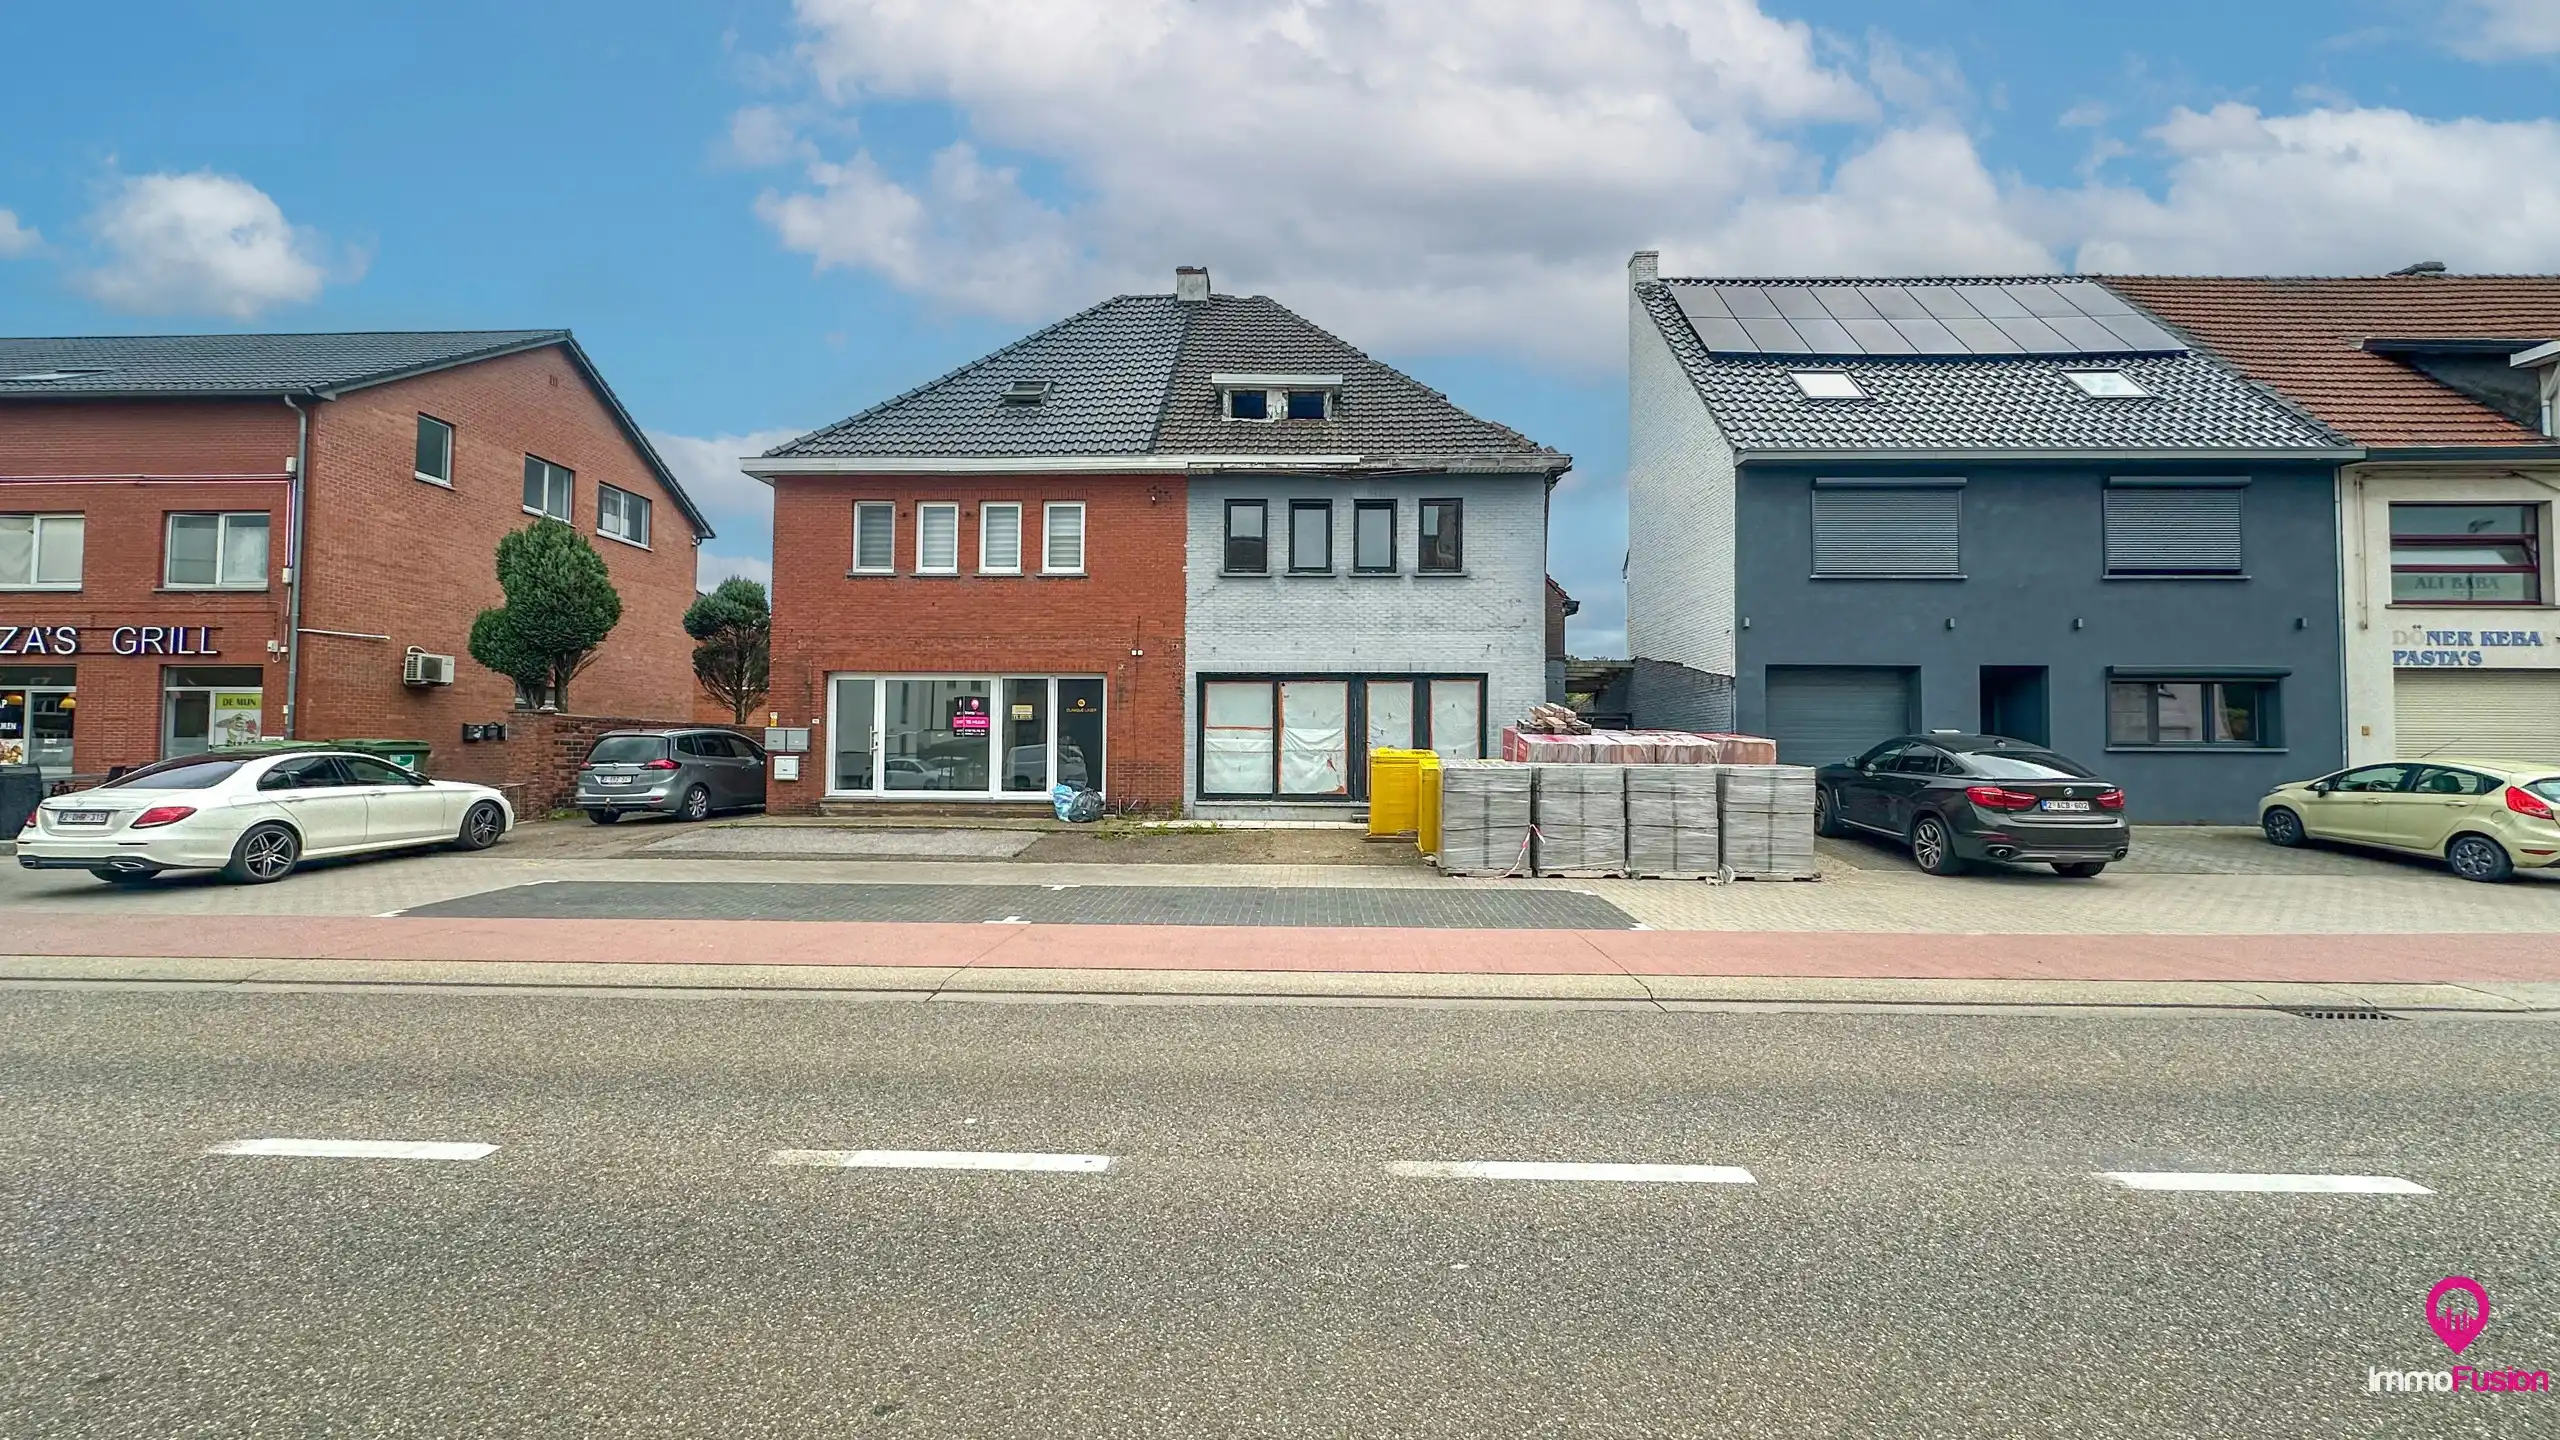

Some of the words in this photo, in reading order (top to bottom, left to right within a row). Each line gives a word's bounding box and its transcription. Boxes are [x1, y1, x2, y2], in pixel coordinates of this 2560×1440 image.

[2414, 576, 2444, 589] ALI
[2451, 576, 2500, 589] BABA
[112, 626, 218, 655] GRILL
[2392, 650, 2482, 666] PASTA'S
[222, 698, 234, 706] DE
